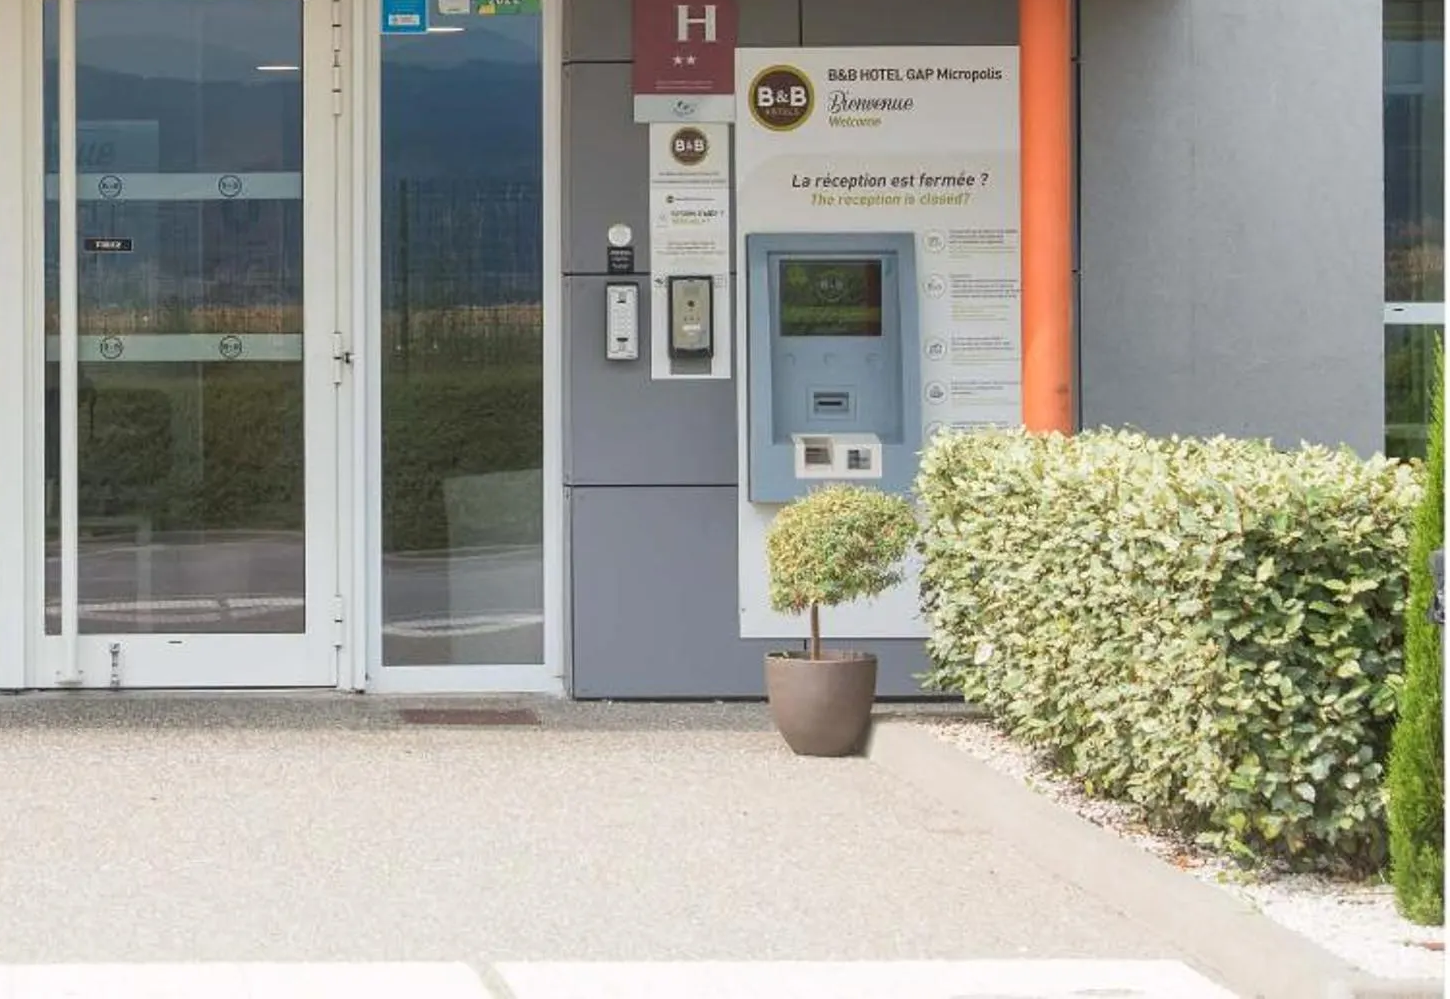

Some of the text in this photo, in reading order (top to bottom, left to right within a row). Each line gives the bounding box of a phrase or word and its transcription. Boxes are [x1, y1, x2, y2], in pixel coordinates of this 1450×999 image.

[675, 4, 717, 42] H
[827, 66, 1003, 83] B&B HOTEL GAP Micropolis
[757, 86, 807, 107] B&B
[792, 171, 990, 190] La réception est fermée ?
[810, 193, 832, 206] The
